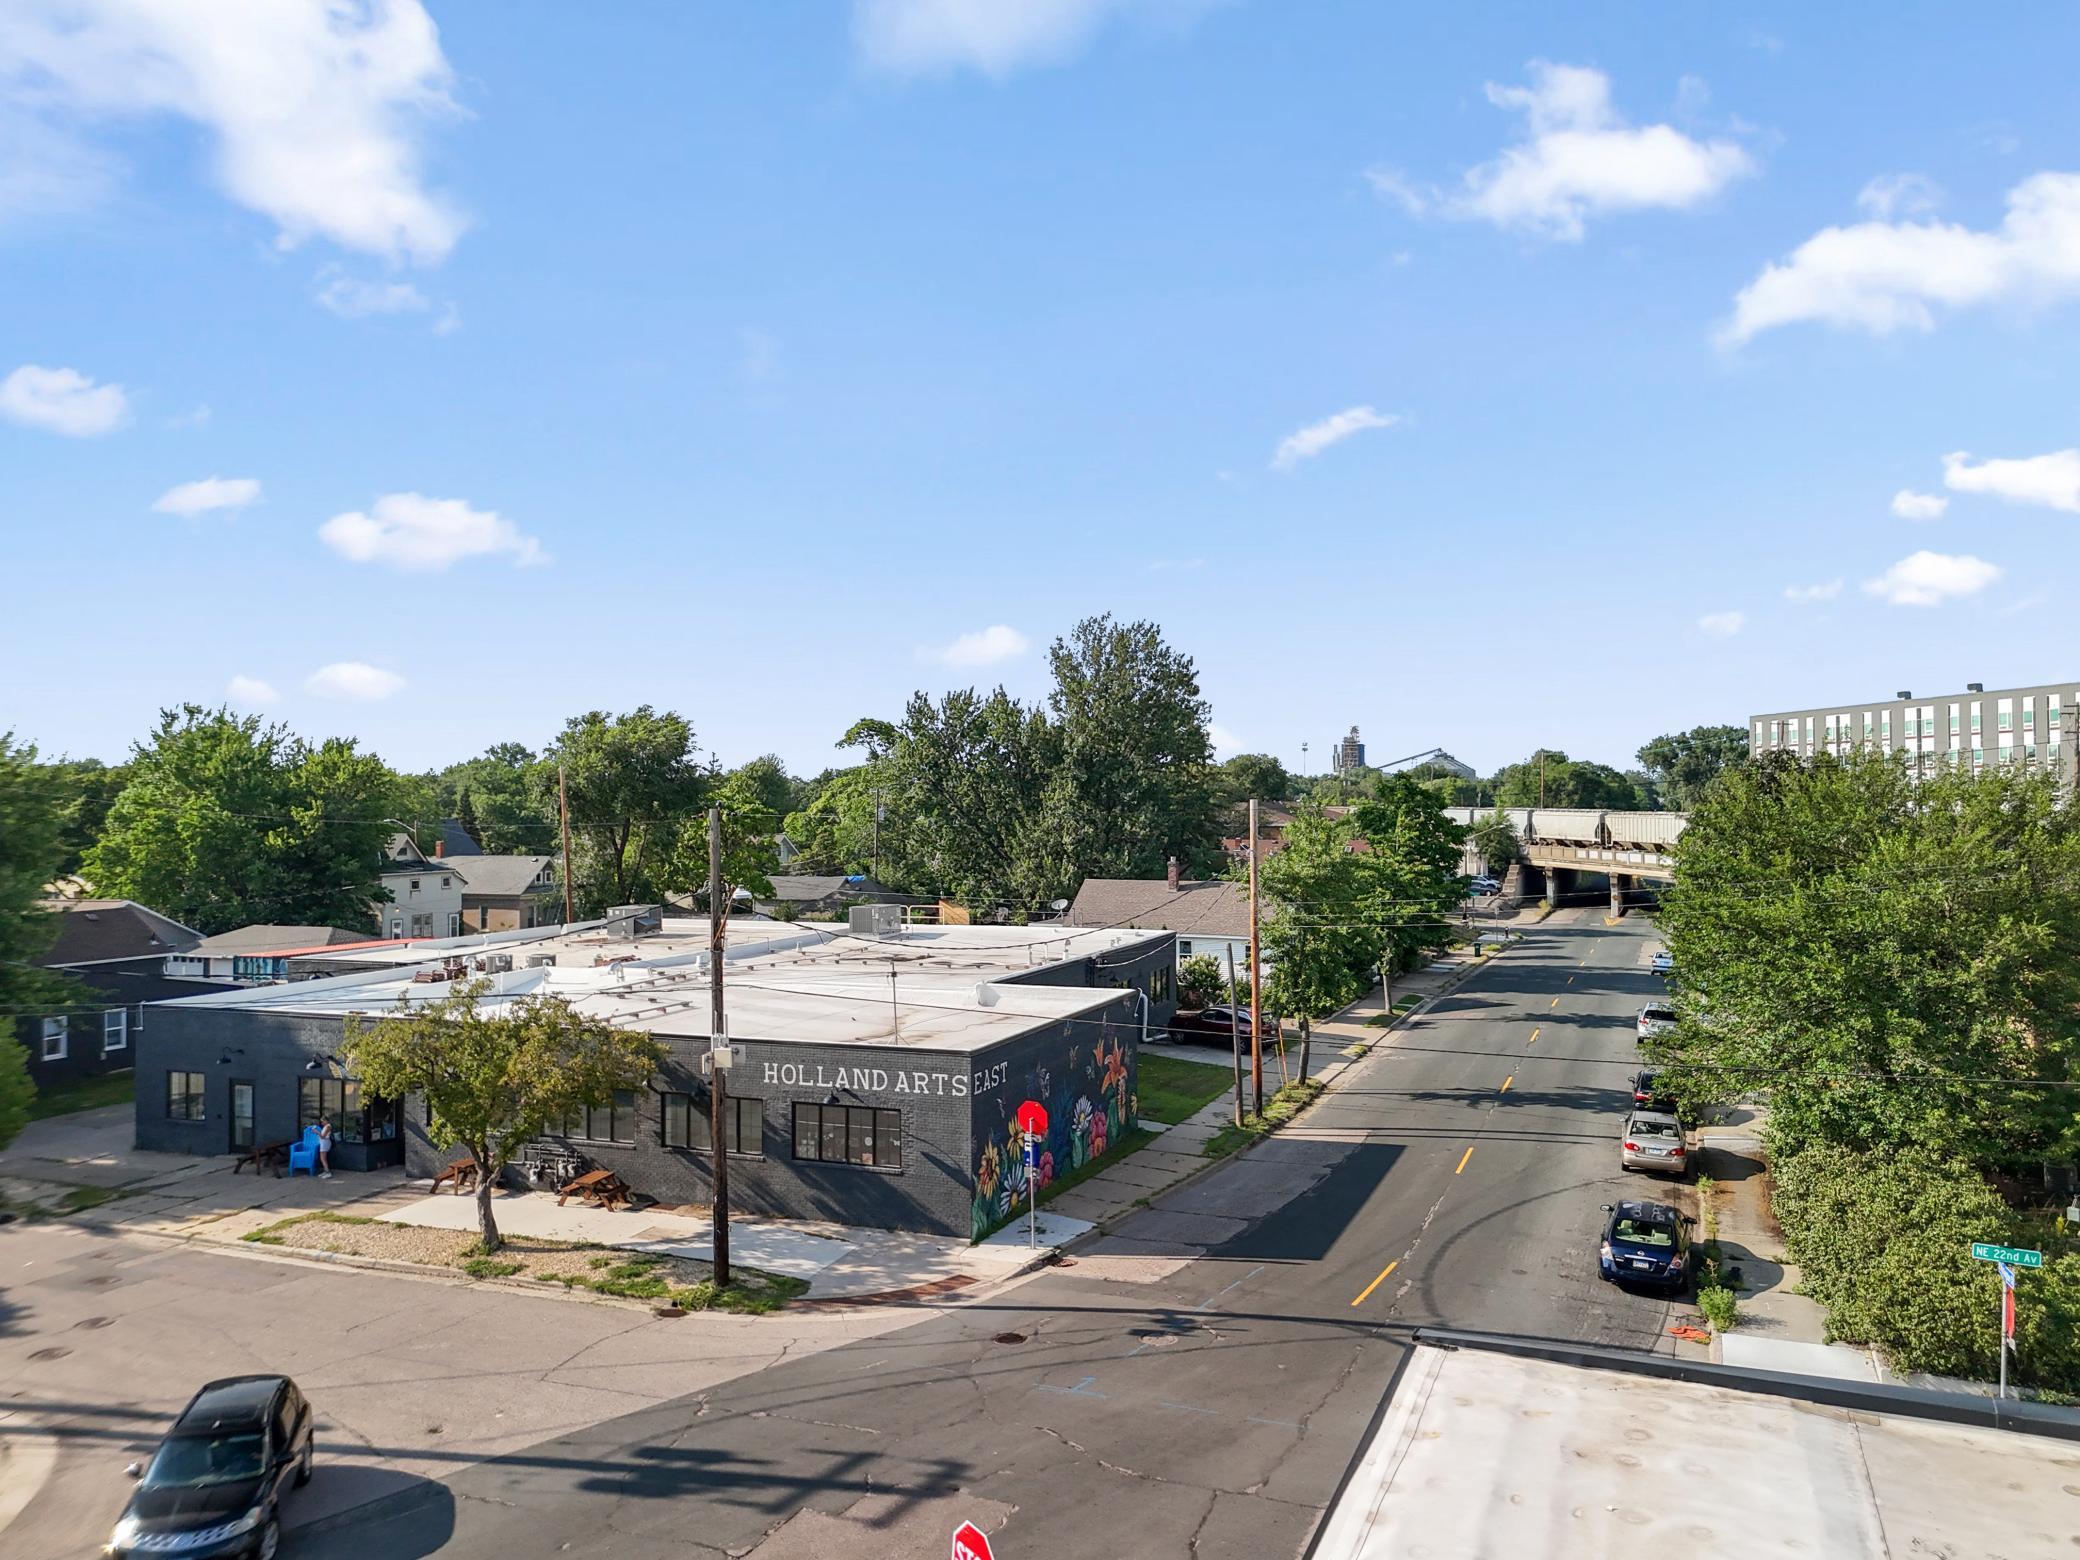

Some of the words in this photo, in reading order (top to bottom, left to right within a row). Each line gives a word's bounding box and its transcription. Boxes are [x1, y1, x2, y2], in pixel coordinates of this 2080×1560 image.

[763, 1062, 888, 1091] HOLLAND
[894, 1071, 968, 1097] ARTS
[973, 1061, 1008, 1096] EAST
[1976, 1246, 1989, 1257] NE
[1993, 1249, 2020, 1262] 22nd
[2023, 1253, 2038, 1264] Av
[954, 1540, 982, 1560] ST
